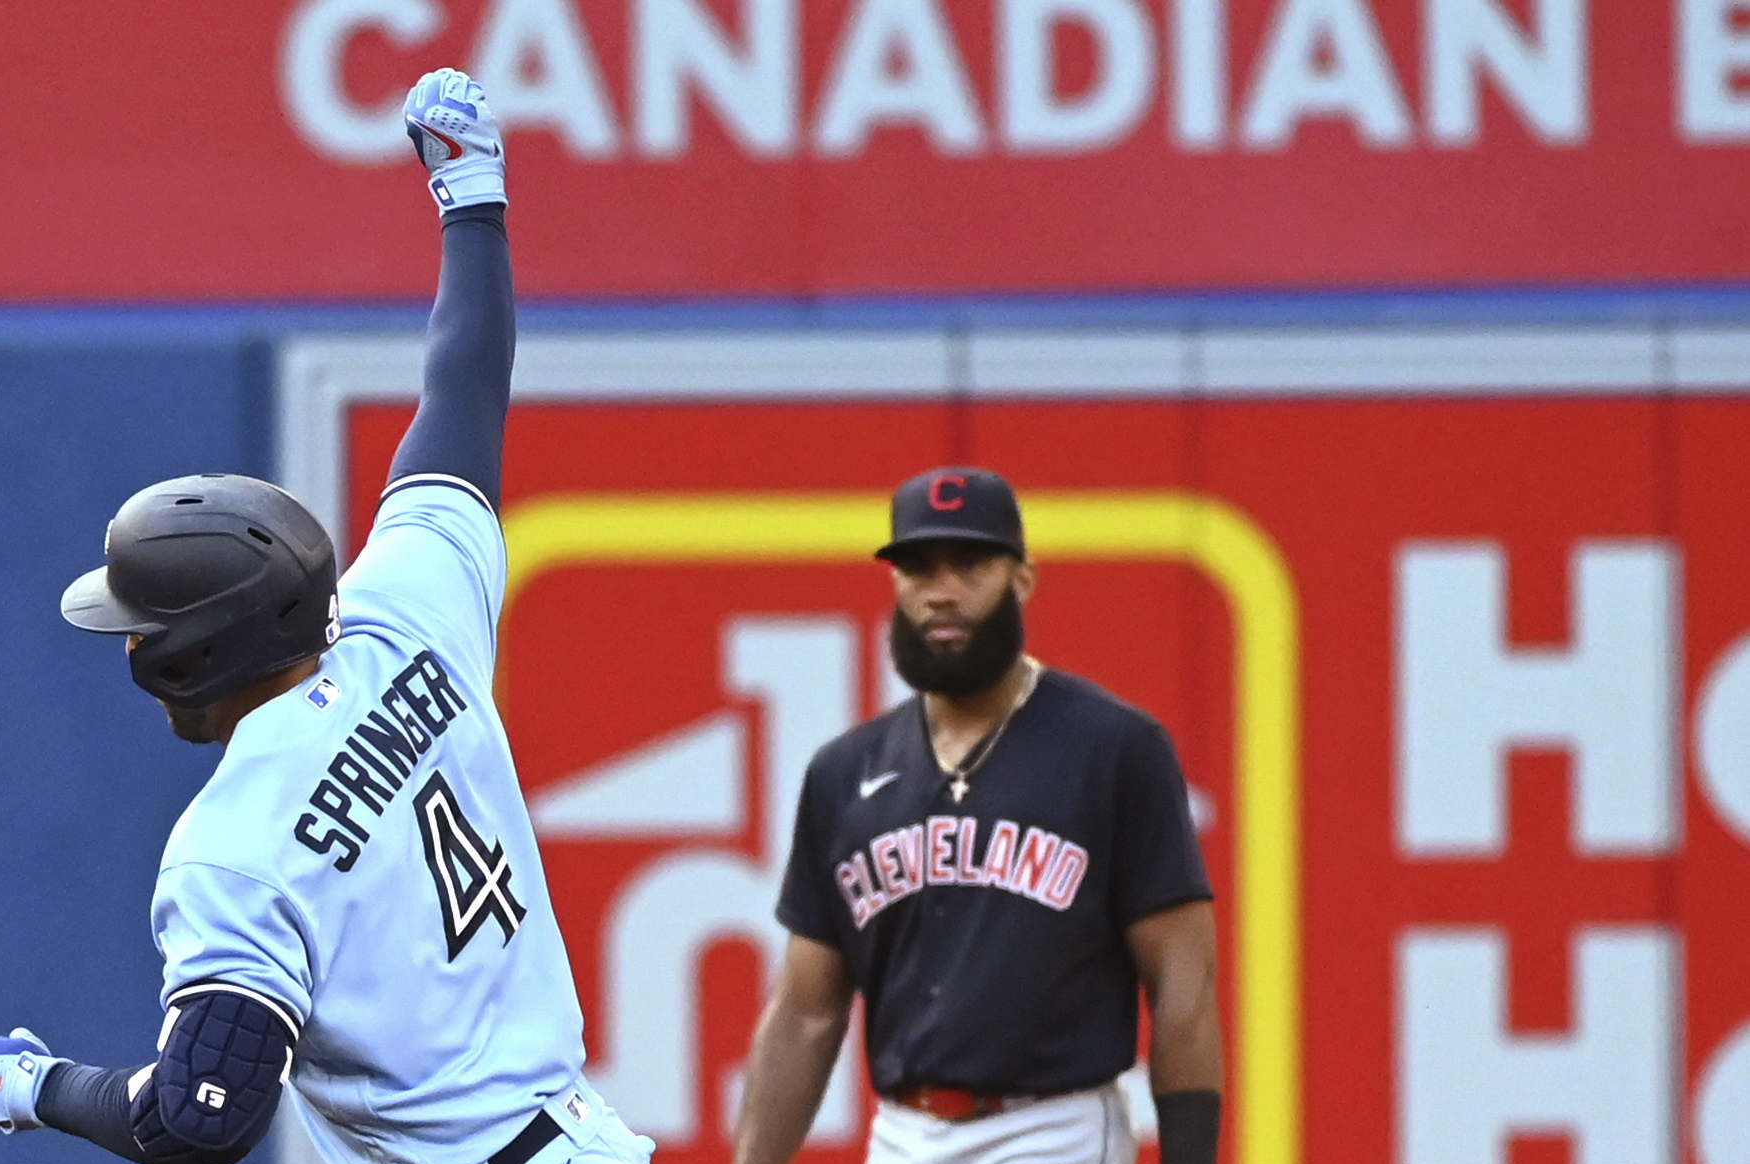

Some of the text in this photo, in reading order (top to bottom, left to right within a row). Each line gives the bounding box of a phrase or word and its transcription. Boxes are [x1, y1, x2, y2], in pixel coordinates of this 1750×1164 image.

[278, 0, 1590, 164] CANADIAN
[930, 476, 966, 511] C
[294, 650, 467, 872] SPRINGER
[412, 769, 527, 963] 4
[834, 814, 1089, 931] CLEVELAND
